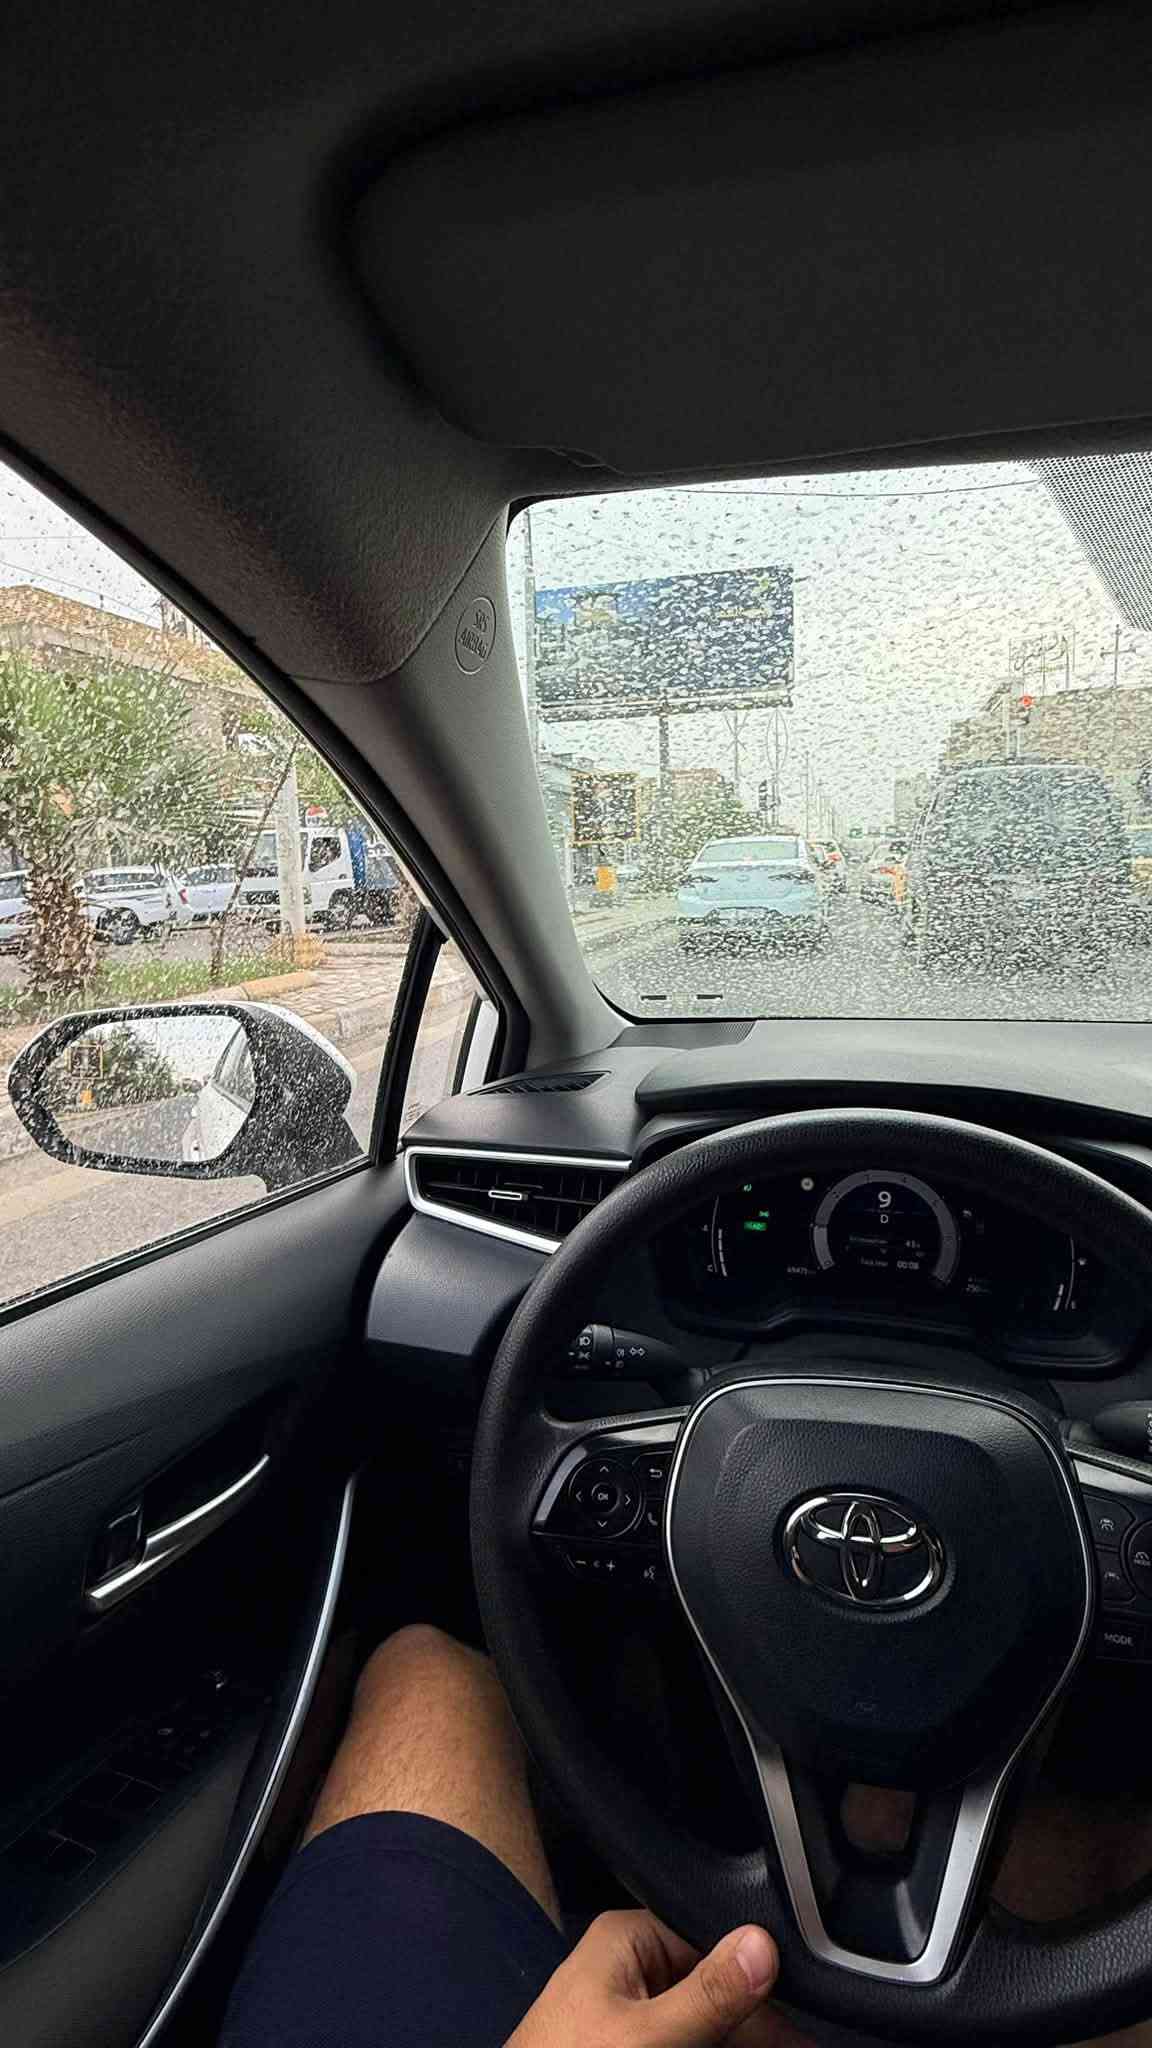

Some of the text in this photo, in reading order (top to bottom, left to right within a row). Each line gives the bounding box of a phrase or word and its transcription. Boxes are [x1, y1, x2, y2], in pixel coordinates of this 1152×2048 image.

[877, 1190, 893, 1208] 9
[879, 1214, 889, 1224] D
[1104, 1631, 1135, 1647] MODE
